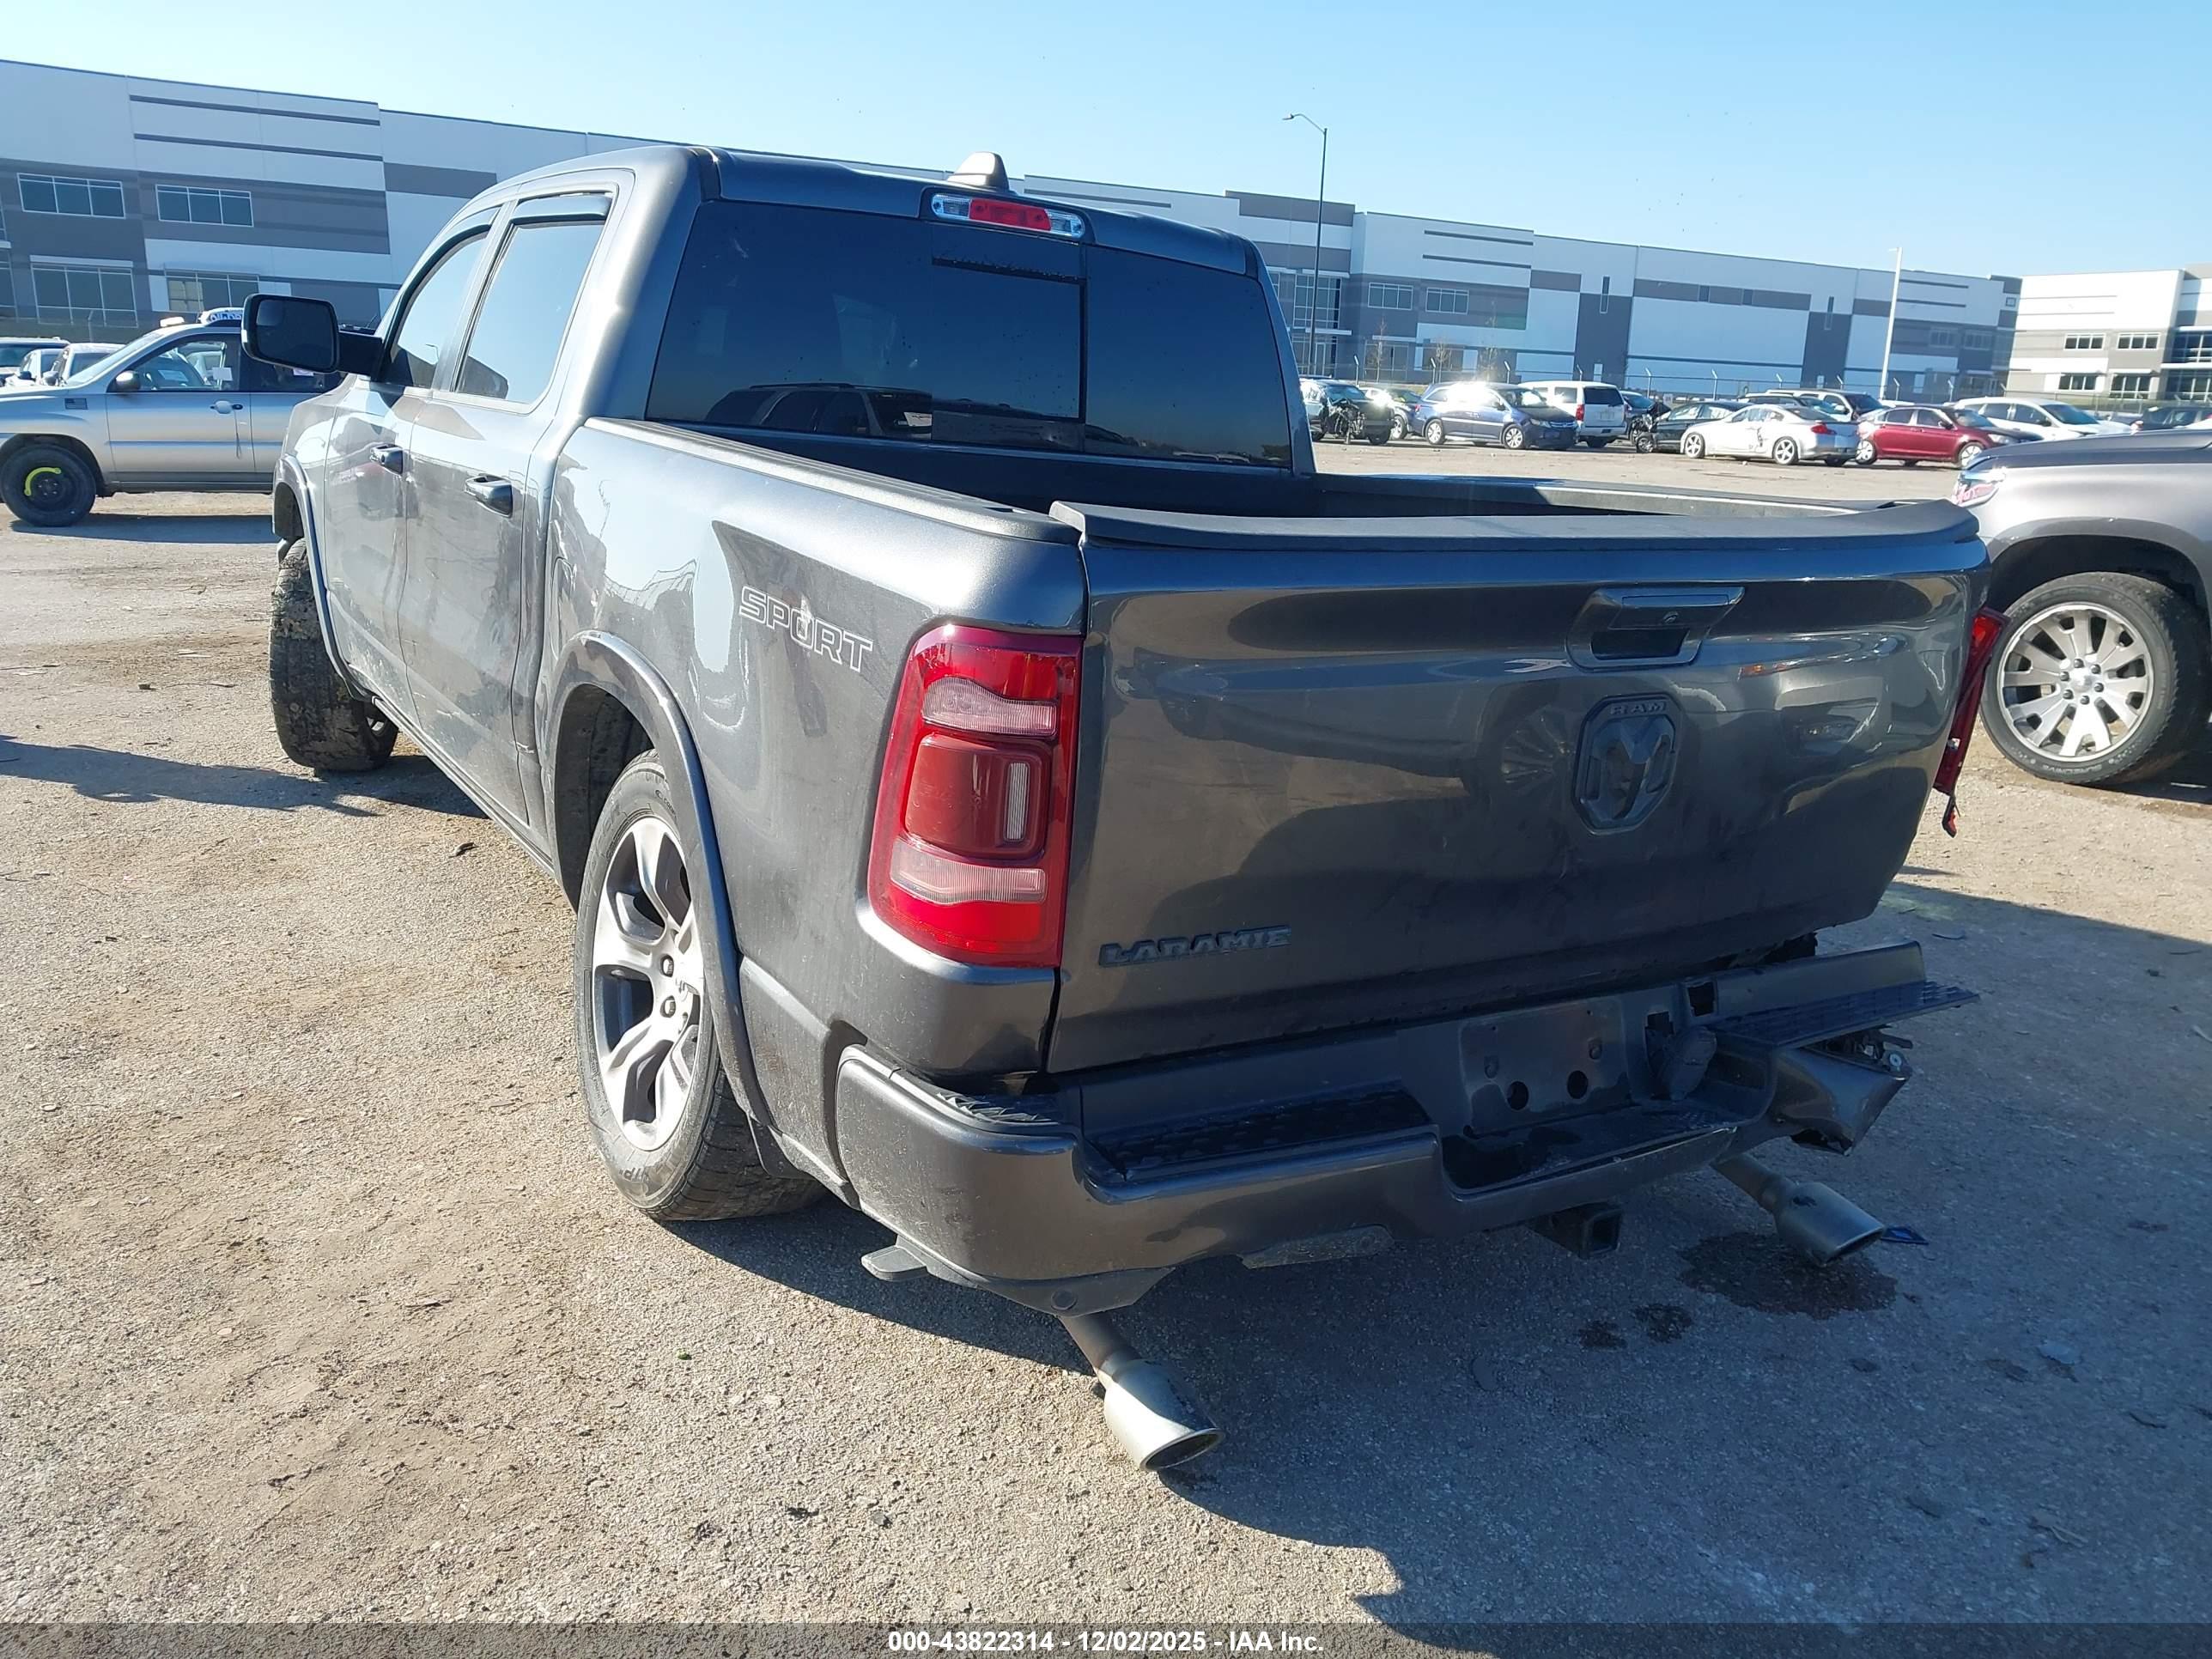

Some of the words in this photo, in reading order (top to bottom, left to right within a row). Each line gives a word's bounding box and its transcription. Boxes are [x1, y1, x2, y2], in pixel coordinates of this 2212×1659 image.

[739, 586, 874, 673] SPORT
[1609, 701, 1668, 716] RAM
[1099, 925, 1291, 968] LARAMIE
